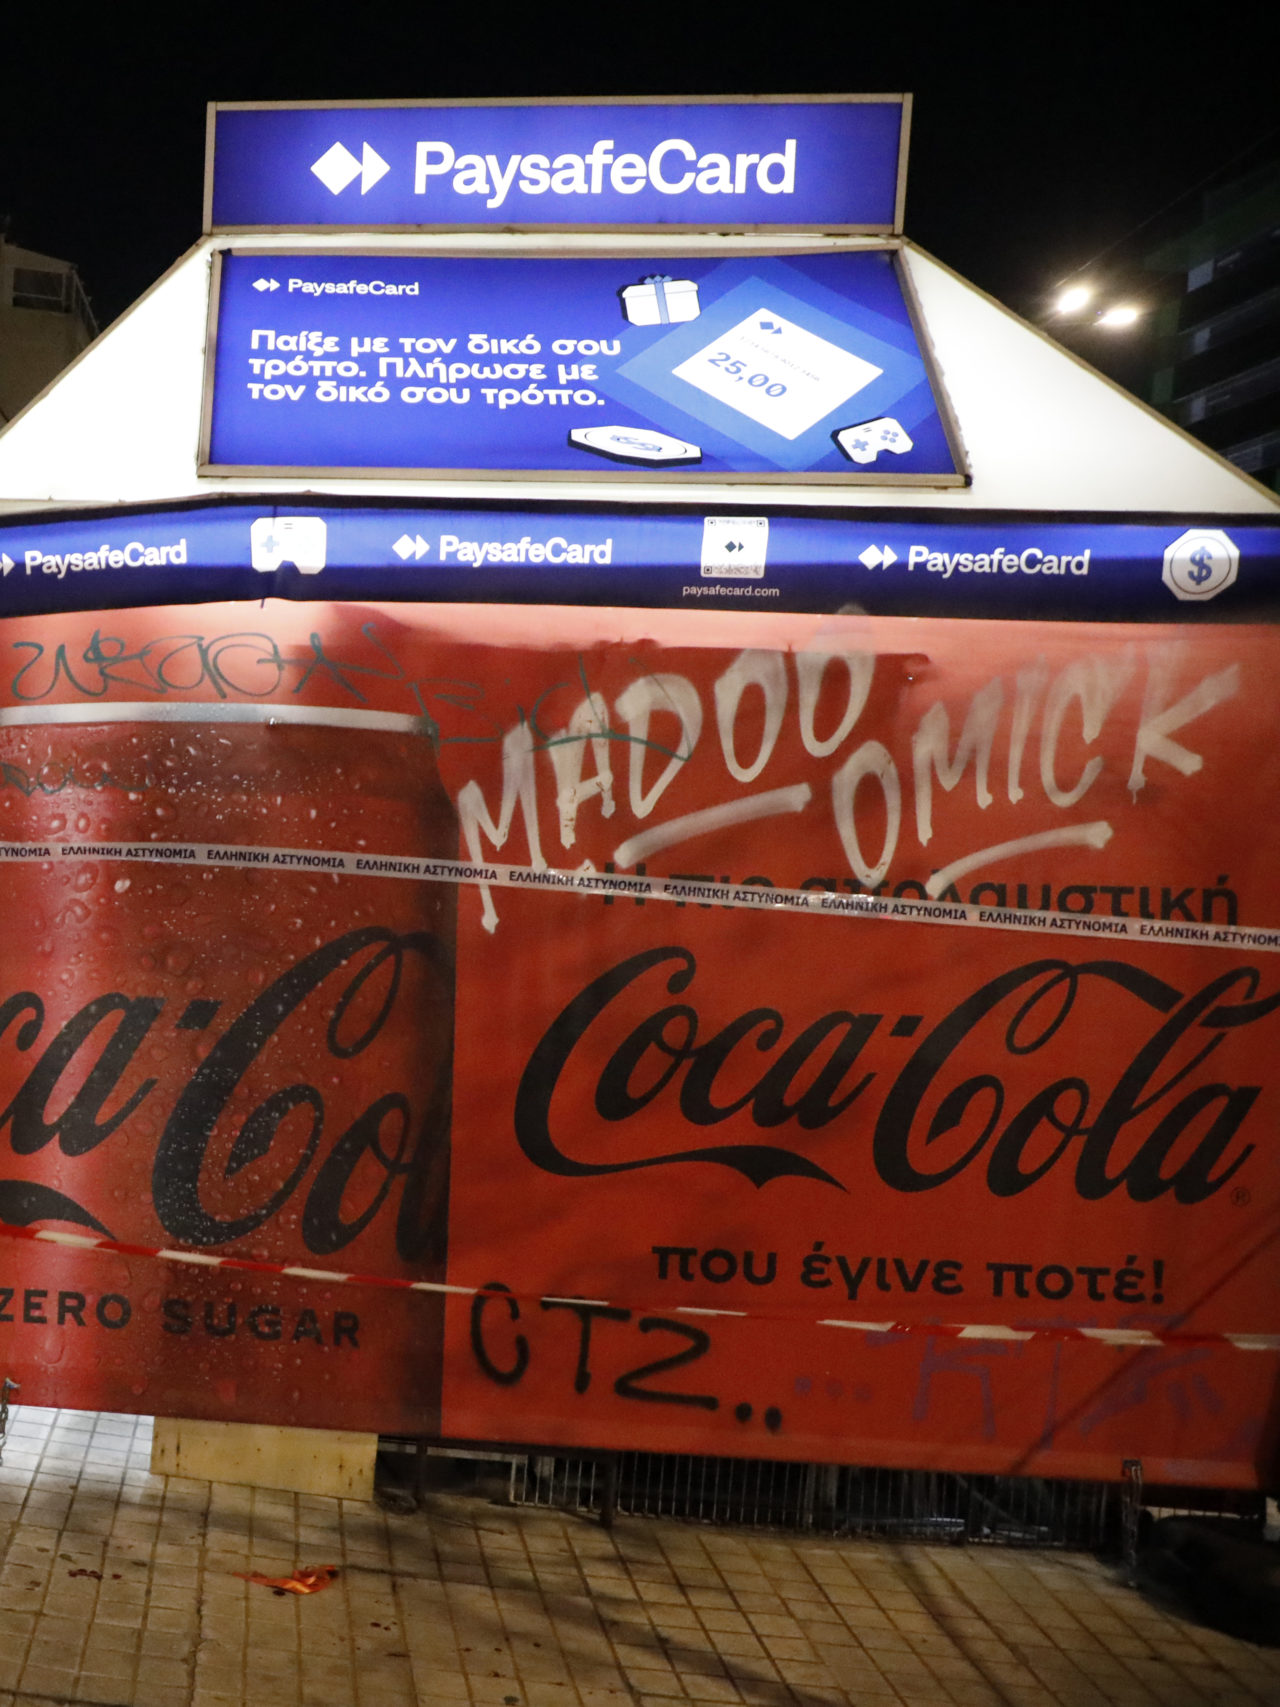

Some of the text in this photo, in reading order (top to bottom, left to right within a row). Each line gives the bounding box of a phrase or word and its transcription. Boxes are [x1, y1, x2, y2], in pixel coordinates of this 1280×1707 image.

[413, 138, 798, 208] PaysafeCard
[287, 278, 420, 297] PaysafeCard
[250, 329, 621, 357] Παίξε με τον δικό σου
[248, 355, 600, 384] τρόπο. Πλήρωσε με
[707, 352, 787, 397] 25,00
[247, 380, 606, 410] τον δικό σου τρόπο.
[24, 537, 188, 579] PaysafeCard
[438, 535, 612, 567] PaysafeCard
[907, 545, 1090, 579] PaysafeCard
[682, 584, 780, 598] paysafecard.com
[61, 846, 122, 857] ΕΛΛΗΝΙΚΗ
[125, 848, 196, 860] ΑΣΤΥΝΟΜΙΑ
[207, 849, 269, 863] ΕΛΛΗΝΙΚΗ
[272, 855, 346, 869] ΑΣΤΥΝΟΜΙΑ
[355, 858, 420, 874] ΕΛΛΗΝΙΚΗ
[423, 864, 498, 881] ΑΣΤΥΝΟΜΙΑ
[508, 871, 574, 888] ΕΛΛΗΝΙΚΗ
[577, 877, 652, 894] ΑΣΤΥΝΟΜΙΑ
[663, 884, 730, 901] ΕΛΛΗΝΙΚΗ
[733, 890, 810, 908] ΑΣΤΥΝΟΜΙΑ
[820, 897, 888, 914] ΕΛΛΗΝΙΚΗ
[891, 904, 968, 921] ΑΣΤΥΝΟΜΙΑ
[978, 910, 1046, 928] ΕΛΛΗΝΙΚΗ
[1050, 917, 1128, 934] ΑΣΤΥΝΟΜΙΑ
[1140, 924, 1209, 940] ΕΛΛΗΝΙΚΗ
[514, 946, 1280, 1205] Coca-Cola
[652, 1241, 1166, 1305] που έγινε ποτέ!
[162, 1298, 361, 1348] SUGAR
